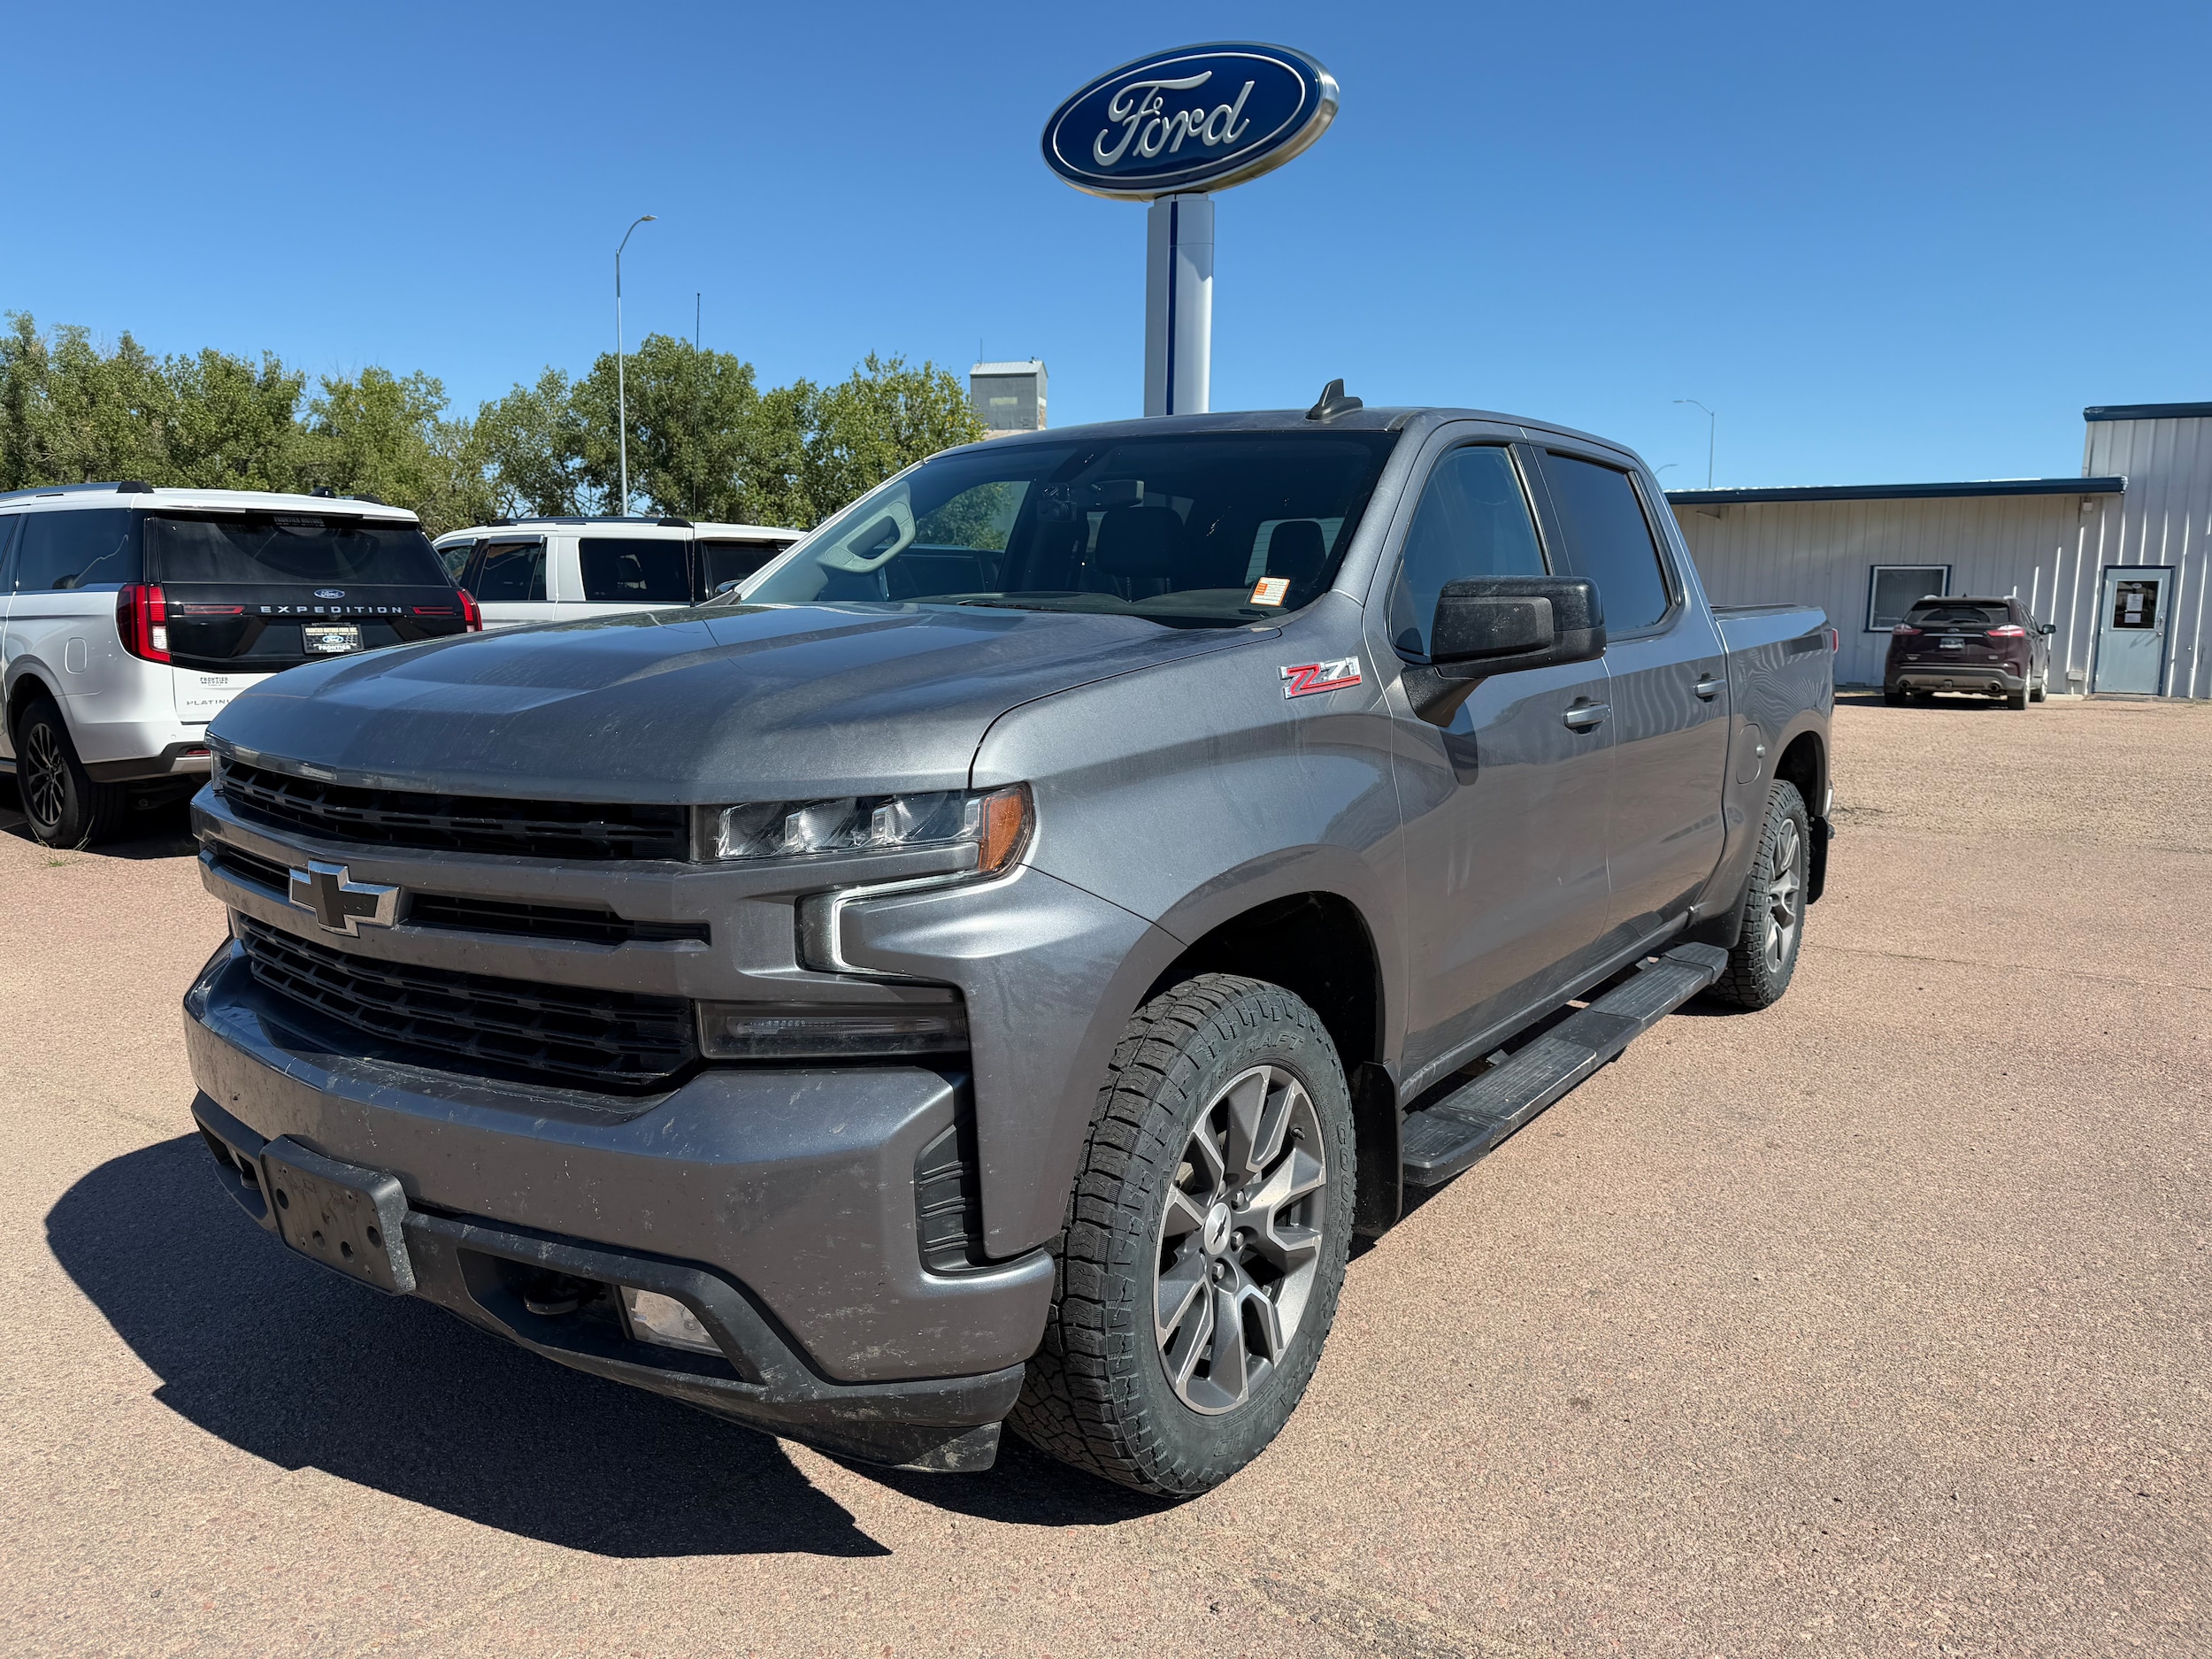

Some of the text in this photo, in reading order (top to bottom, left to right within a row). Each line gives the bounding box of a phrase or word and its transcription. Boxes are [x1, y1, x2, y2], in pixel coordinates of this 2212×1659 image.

[1093, 70, 1256, 166] Ford
[319, 588, 342, 598] Ford
[260, 605, 403, 614] EXPEDITION
[1278, 656, 1362, 700] Z71
[1213, 1429, 1252, 1457] HD
